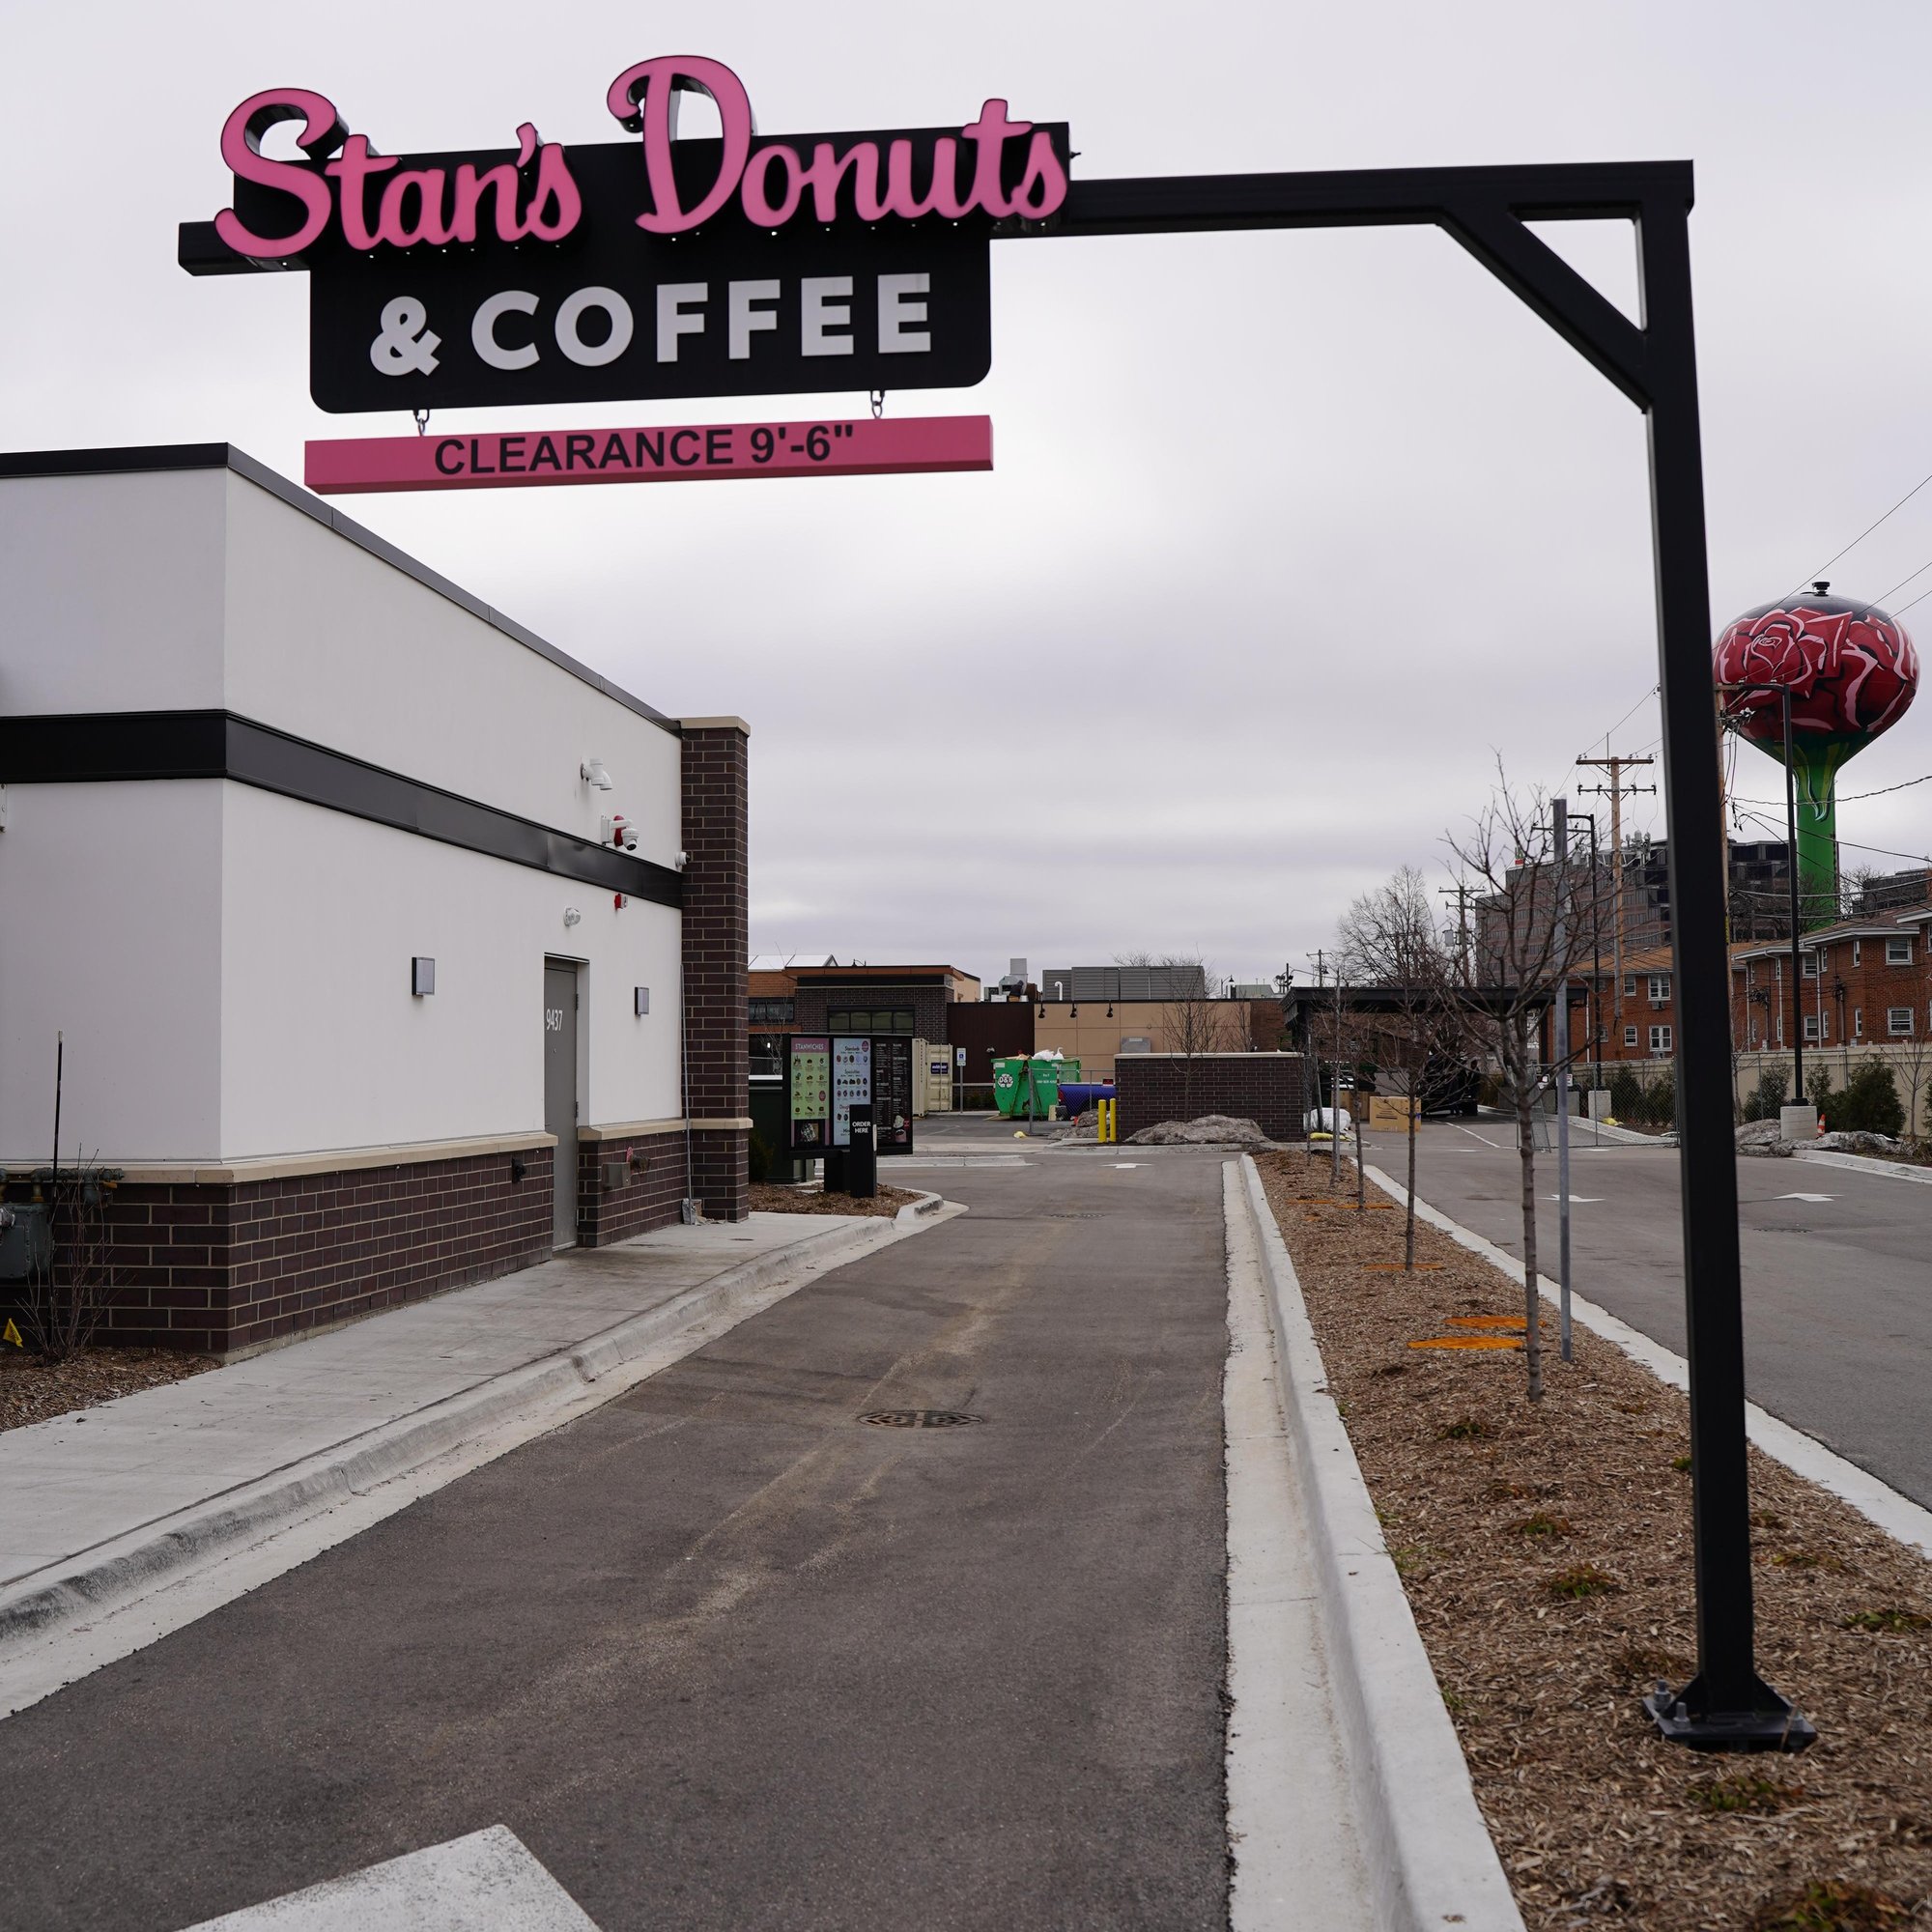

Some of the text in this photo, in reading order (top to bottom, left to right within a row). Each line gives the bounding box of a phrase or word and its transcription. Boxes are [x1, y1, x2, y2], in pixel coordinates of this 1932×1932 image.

[214, 55, 1067, 259] Stan's Donuts
[370, 272, 931, 377] & COFFEE
[435, 425, 854, 475] CLEARANCE 9'-6"
[546, 1008, 563, 1032] 9437
